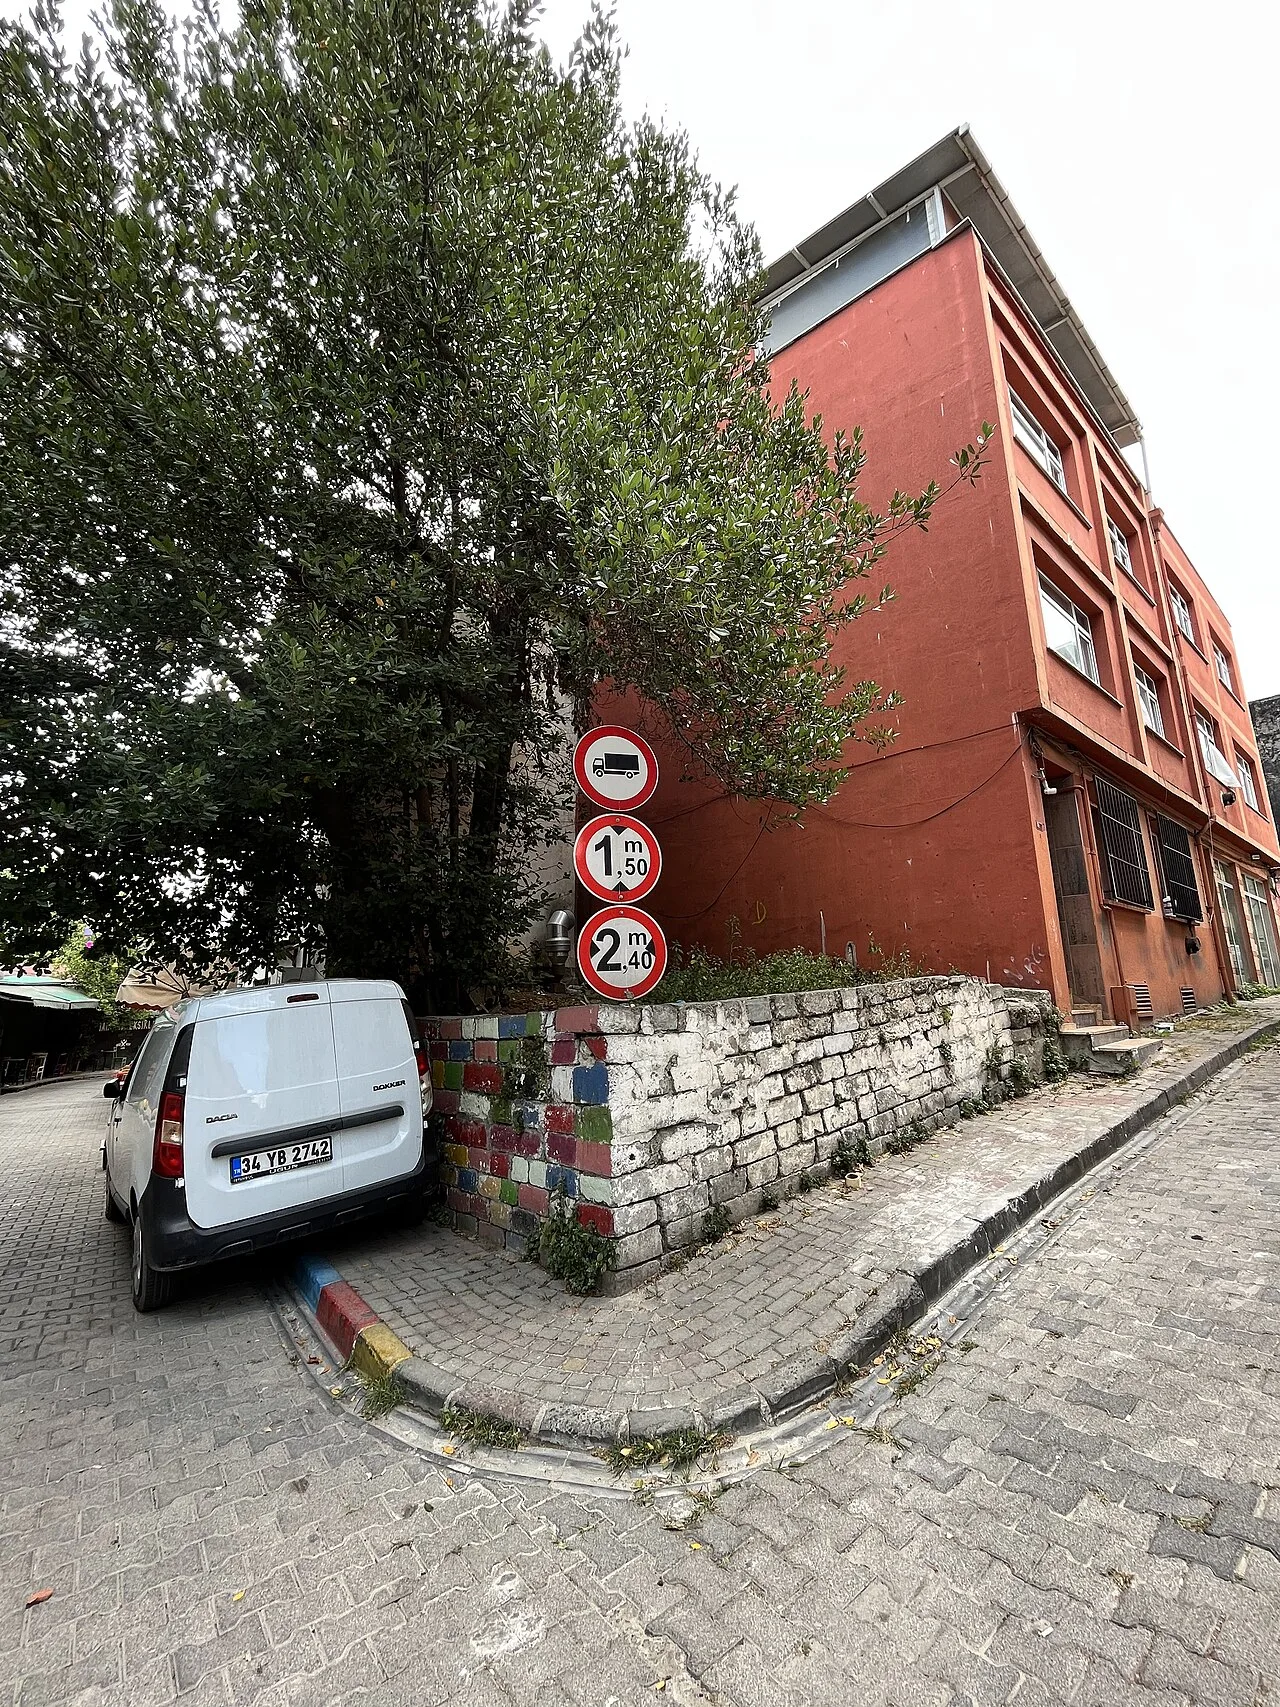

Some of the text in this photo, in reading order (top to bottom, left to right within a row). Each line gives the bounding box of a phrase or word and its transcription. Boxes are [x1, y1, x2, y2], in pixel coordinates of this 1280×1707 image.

[625, 841, 642, 853] m
[629, 932, 647, 945] m
[242, 1156, 261, 1173] 34
[267, 1150, 286, 1168] YB
[292, 1141, 330, 1162] 2742
